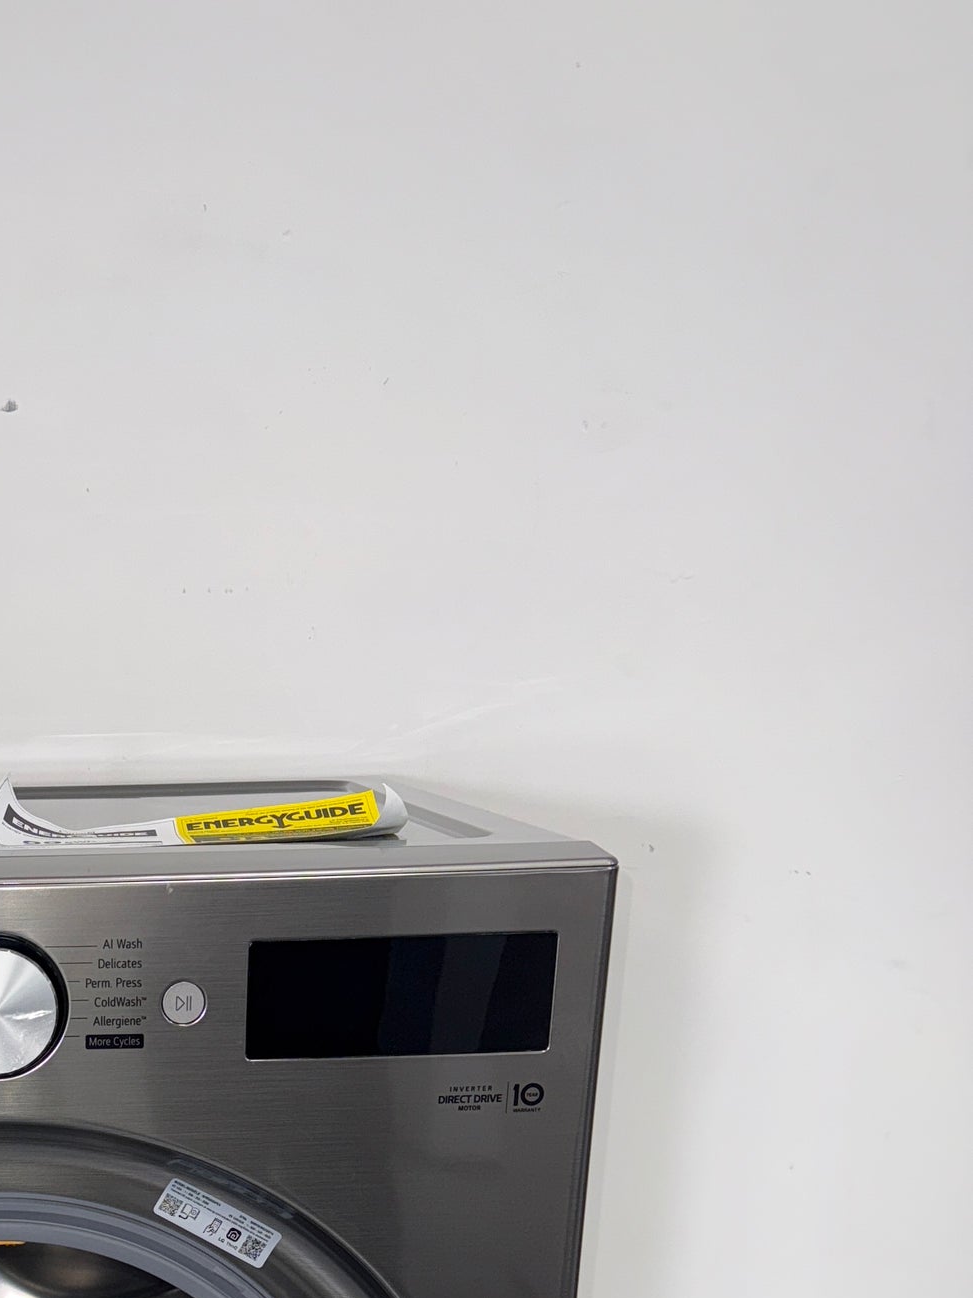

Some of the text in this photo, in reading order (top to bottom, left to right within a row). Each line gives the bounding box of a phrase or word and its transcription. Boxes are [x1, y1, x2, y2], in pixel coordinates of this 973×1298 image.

[187, 802, 367, 829] ENERGYGUIDE
[102, 938, 143, 950] AI Wash
[98, 959, 143, 969] Delicates
[85, 978, 143, 989] Perm. Press
[88, 1037, 141, 1049] More Cycles
[438, 1094, 503, 1104] DIRECT DRIVE
[513, 1082, 544, 1107] 10
